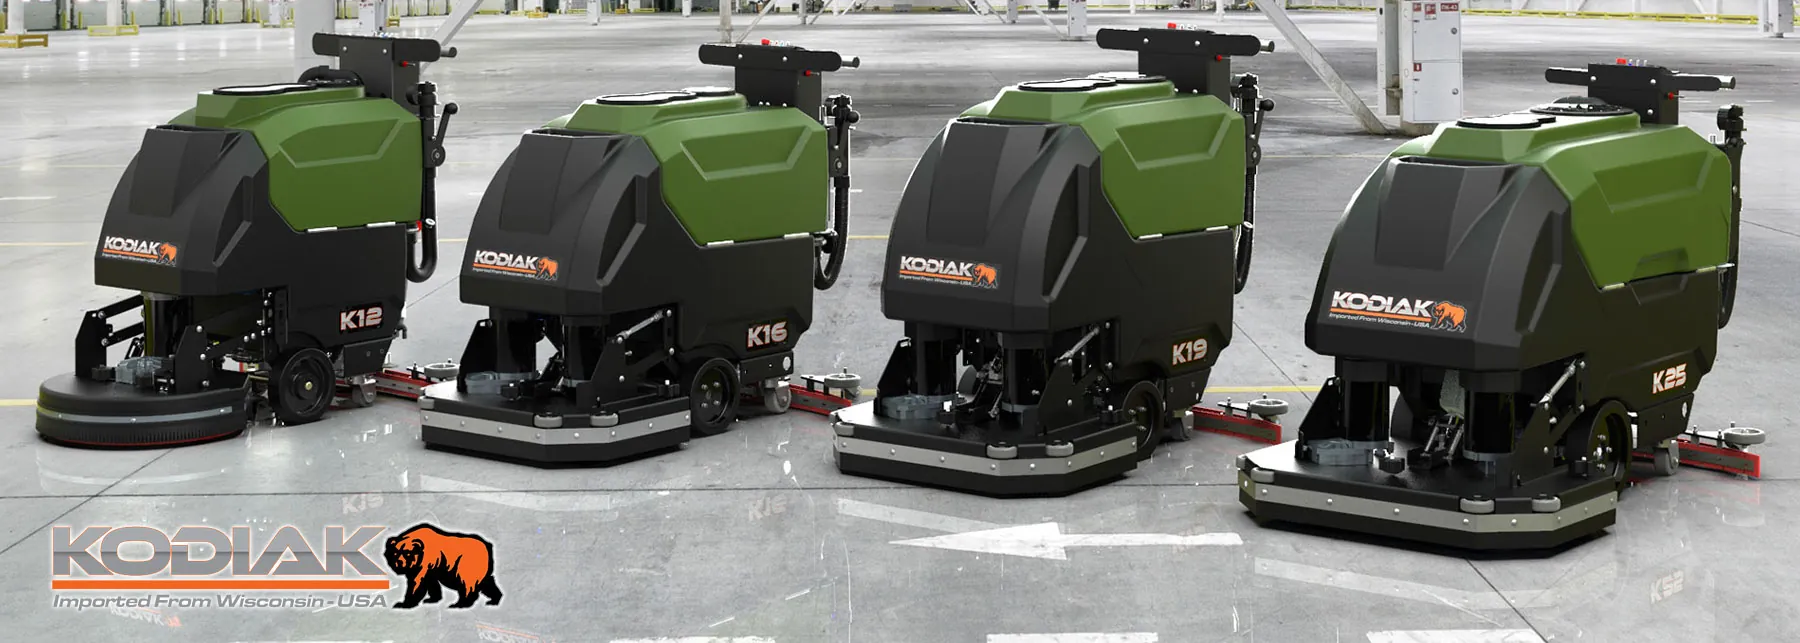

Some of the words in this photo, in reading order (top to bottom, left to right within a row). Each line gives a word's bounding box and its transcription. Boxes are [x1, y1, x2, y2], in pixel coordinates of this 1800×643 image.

[104, 236, 160, 255] KODIAK
[474, 250, 538, 269] KODIAK
[899, 256, 973, 277] KODIAK
[1331, 291, 1434, 317] KODIAK
[340, 306, 382, 331] K12
[1328, 313, 1359, 321] Imported
[747, 321, 787, 348] K16
[1172, 338, 1208, 366] K19
[1652, 362, 1688, 394] K25
